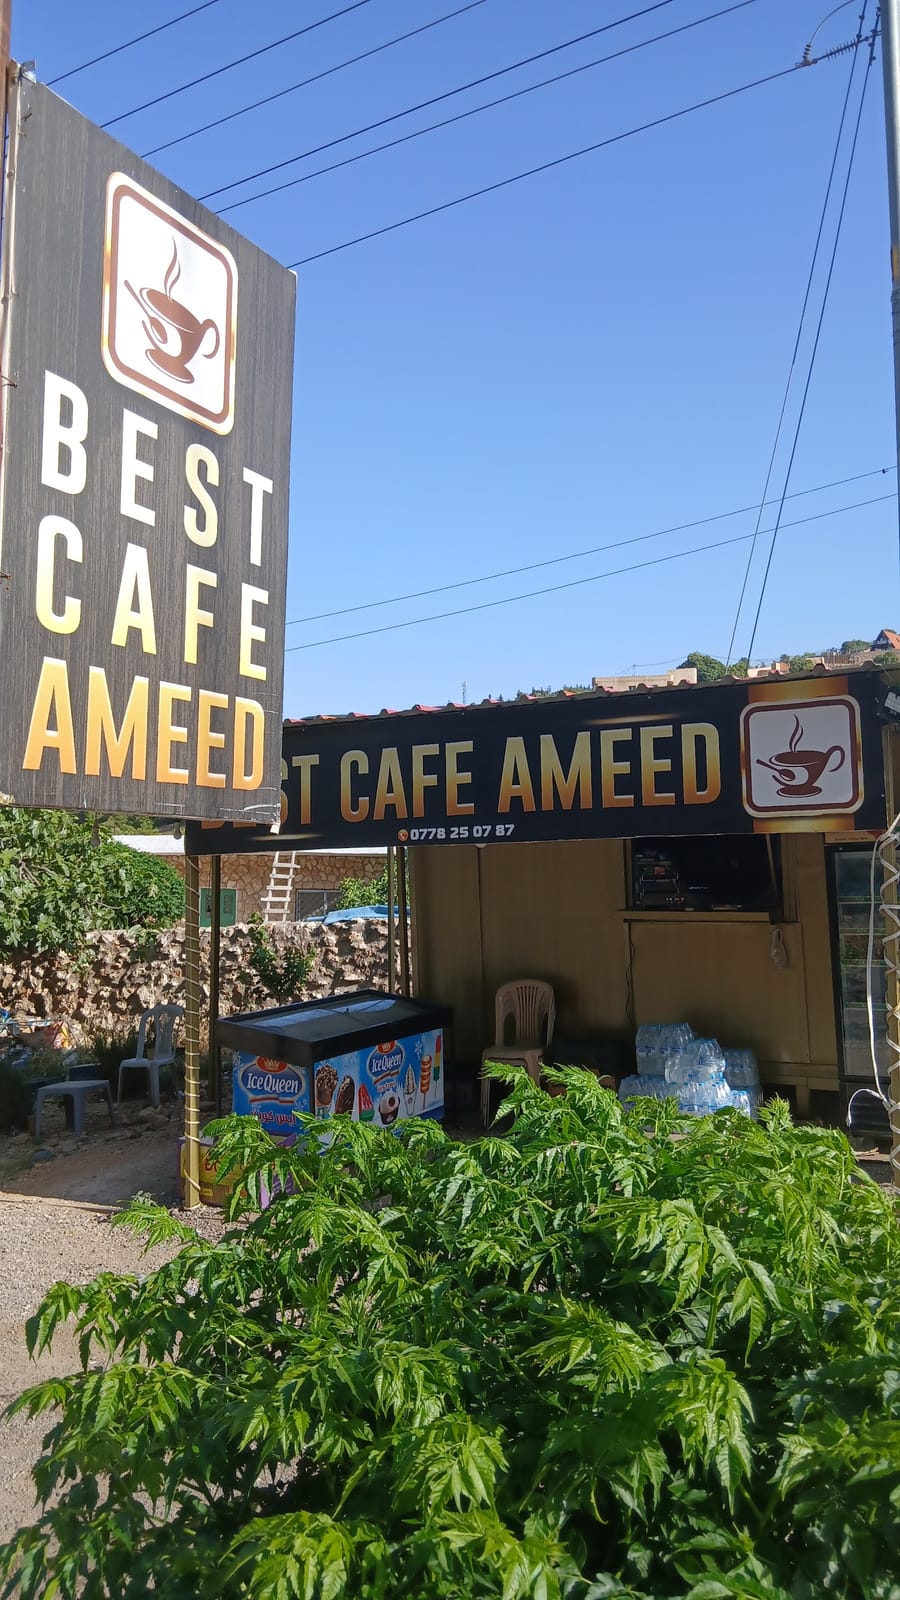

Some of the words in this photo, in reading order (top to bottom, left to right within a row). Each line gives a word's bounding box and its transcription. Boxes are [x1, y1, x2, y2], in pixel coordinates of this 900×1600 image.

[41, 369, 274, 567] BEST
[35, 514, 269, 681] CAFE
[22, 655, 266, 791] AMEED
[340, 740, 475, 823] CAFE
[497, 722, 722, 813] AMEED
[410, 827, 446, 841] 0778
[450, 826, 469, 839] 25
[473, 825, 492, 838] 07
[495, 823, 515, 837] 87
